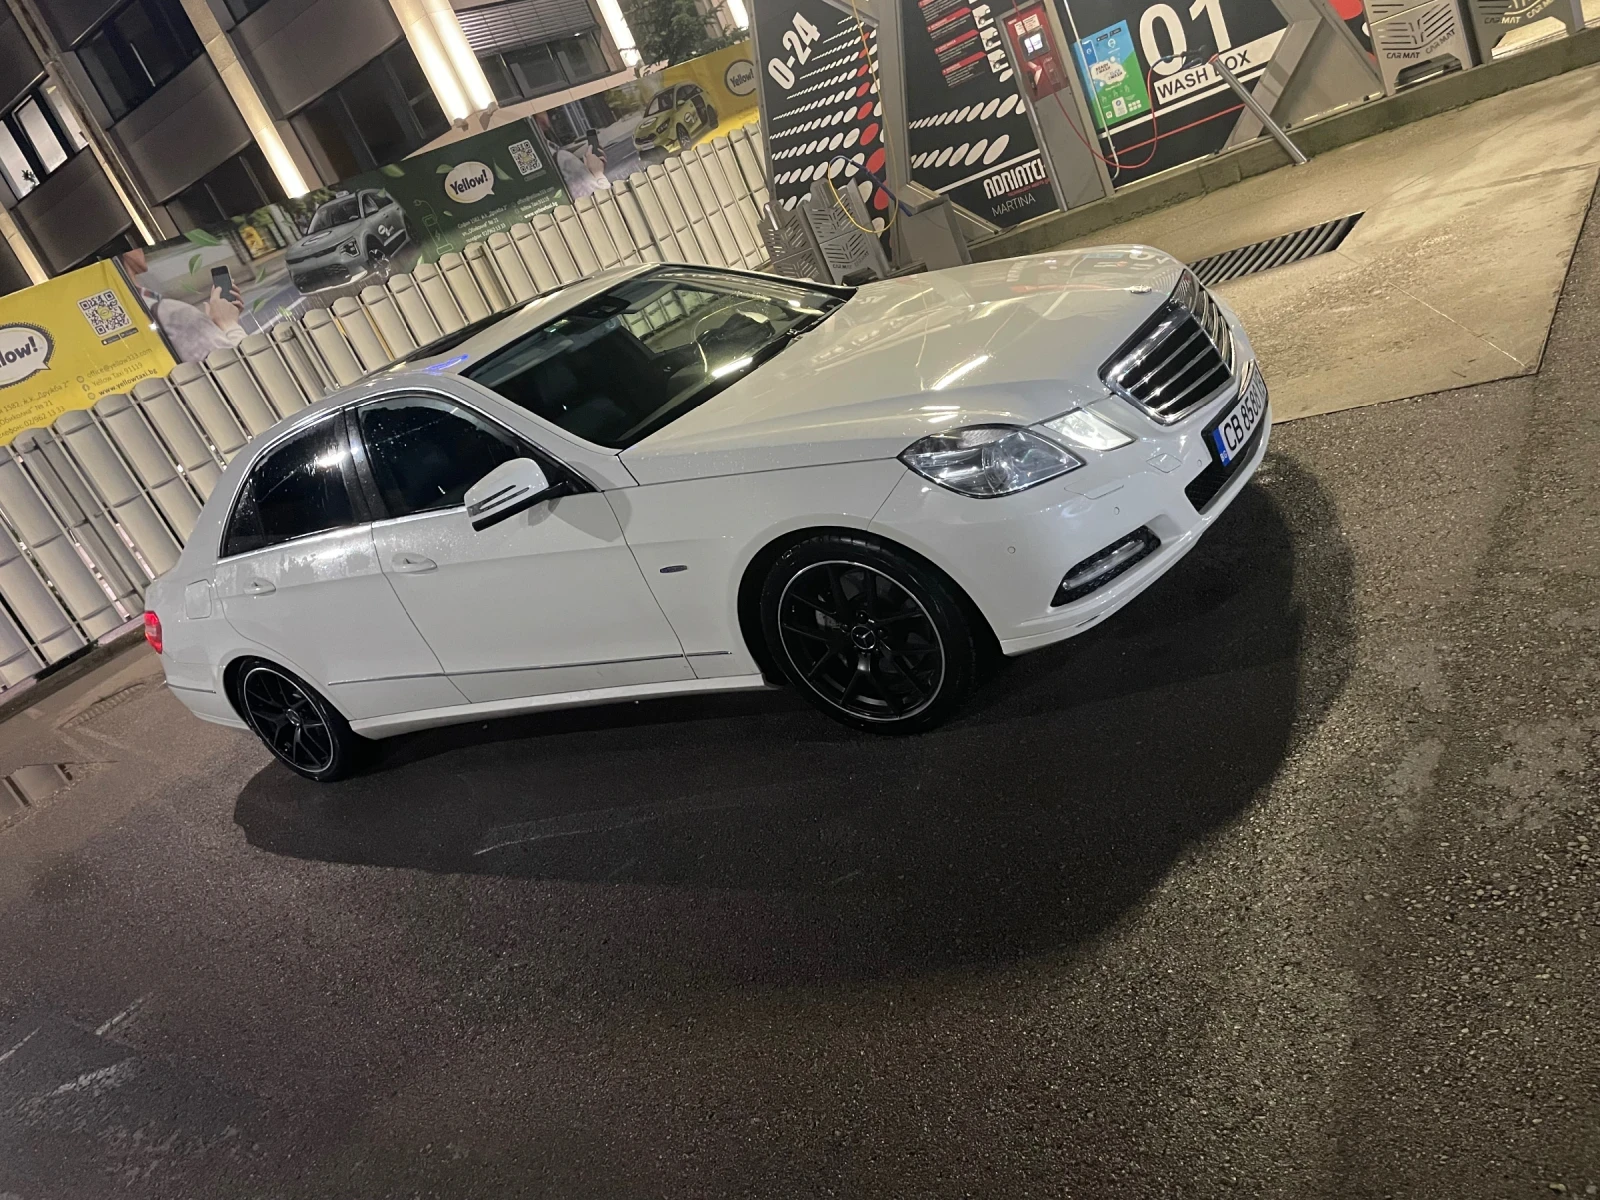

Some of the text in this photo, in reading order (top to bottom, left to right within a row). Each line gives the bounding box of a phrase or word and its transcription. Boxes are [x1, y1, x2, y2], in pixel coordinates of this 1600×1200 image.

[1501, 16, 1521, 24] MAT
[1140, 0, 1232, 76] 01
[1439, 28, 1456, 44] MAT
[768, 12, 820, 90] 0-24
[1402, 51, 1420, 59] MAT
[1157, 67, 1209, 99] WASH
[450, 169, 488, 195] Yellow!
[991, 193, 1036, 217] MARTINA
[92, 362, 143, 387] Yellow Taxi 91119
[98, 368, 158, 396] www.yellowtaxi.bg
